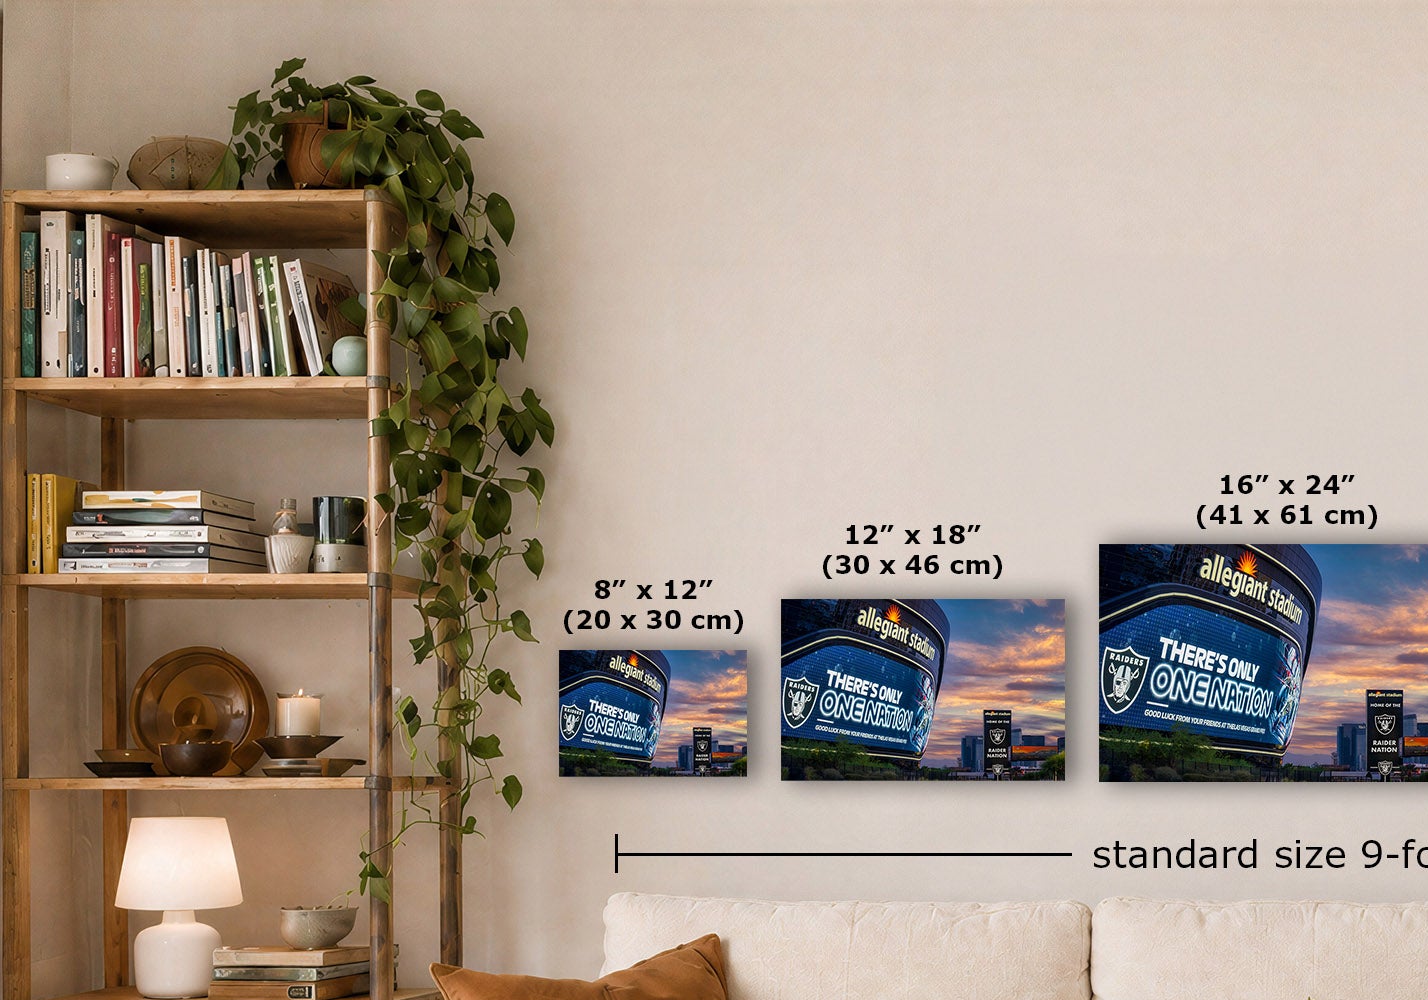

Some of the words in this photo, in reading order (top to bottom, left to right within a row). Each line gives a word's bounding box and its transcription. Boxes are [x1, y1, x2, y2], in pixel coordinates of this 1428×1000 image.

[1200, 554, 1268, 603] allegiant
[1268, 588, 1302, 625] stadium
[857, 606, 909, 644] allegiant
[909, 633, 935, 660] stadium
[609, 655, 643, 681] allegiant
[643, 673, 661, 693] stadium
[1109, 653, 1143, 666] RAIDERS
[1160, 636, 1228, 673] THERE'S
[1228, 658, 1259, 682] ONLY
[789, 682, 814, 692] RAIDERS
[827, 669, 878, 697] THERE'S
[879, 685, 902, 704] ONLY
[1151, 664, 1211, 705] ONE
[1208, 677, 1273, 718] NATION
[585, 713, 615, 735] ONE
[614, 720, 646, 742] NATION
[589, 699, 623, 718] THERE'S
[624, 710, 639, 723] ONLY
[820, 690, 866, 722] ONE
[864, 700, 913, 731] NATION
[1144, 709, 1161, 718] GOOD
[1161, 712, 1175, 720] LUCK
[1191, 717, 1203, 725] YOUR
